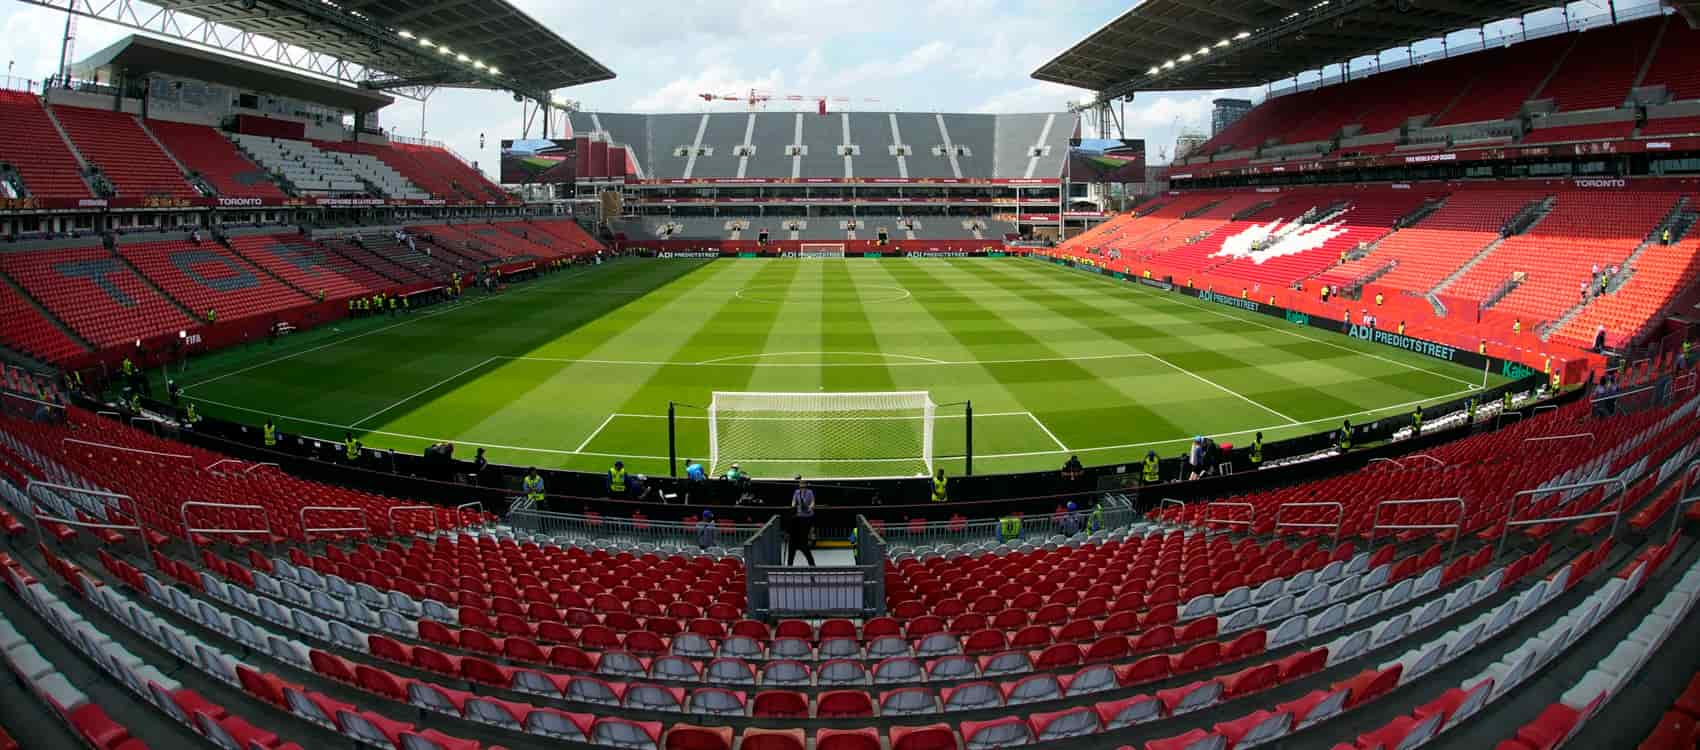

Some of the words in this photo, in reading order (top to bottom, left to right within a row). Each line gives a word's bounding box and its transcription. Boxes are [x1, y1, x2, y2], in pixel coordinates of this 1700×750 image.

[1574, 179, 1625, 187] TORONTO
[219, 198, 262, 206] TORONTO
[186, 334, 202, 345] FIFA
[1348, 324, 1372, 344] ADI
[1374, 330, 1456, 361] PREDICTSTREET
